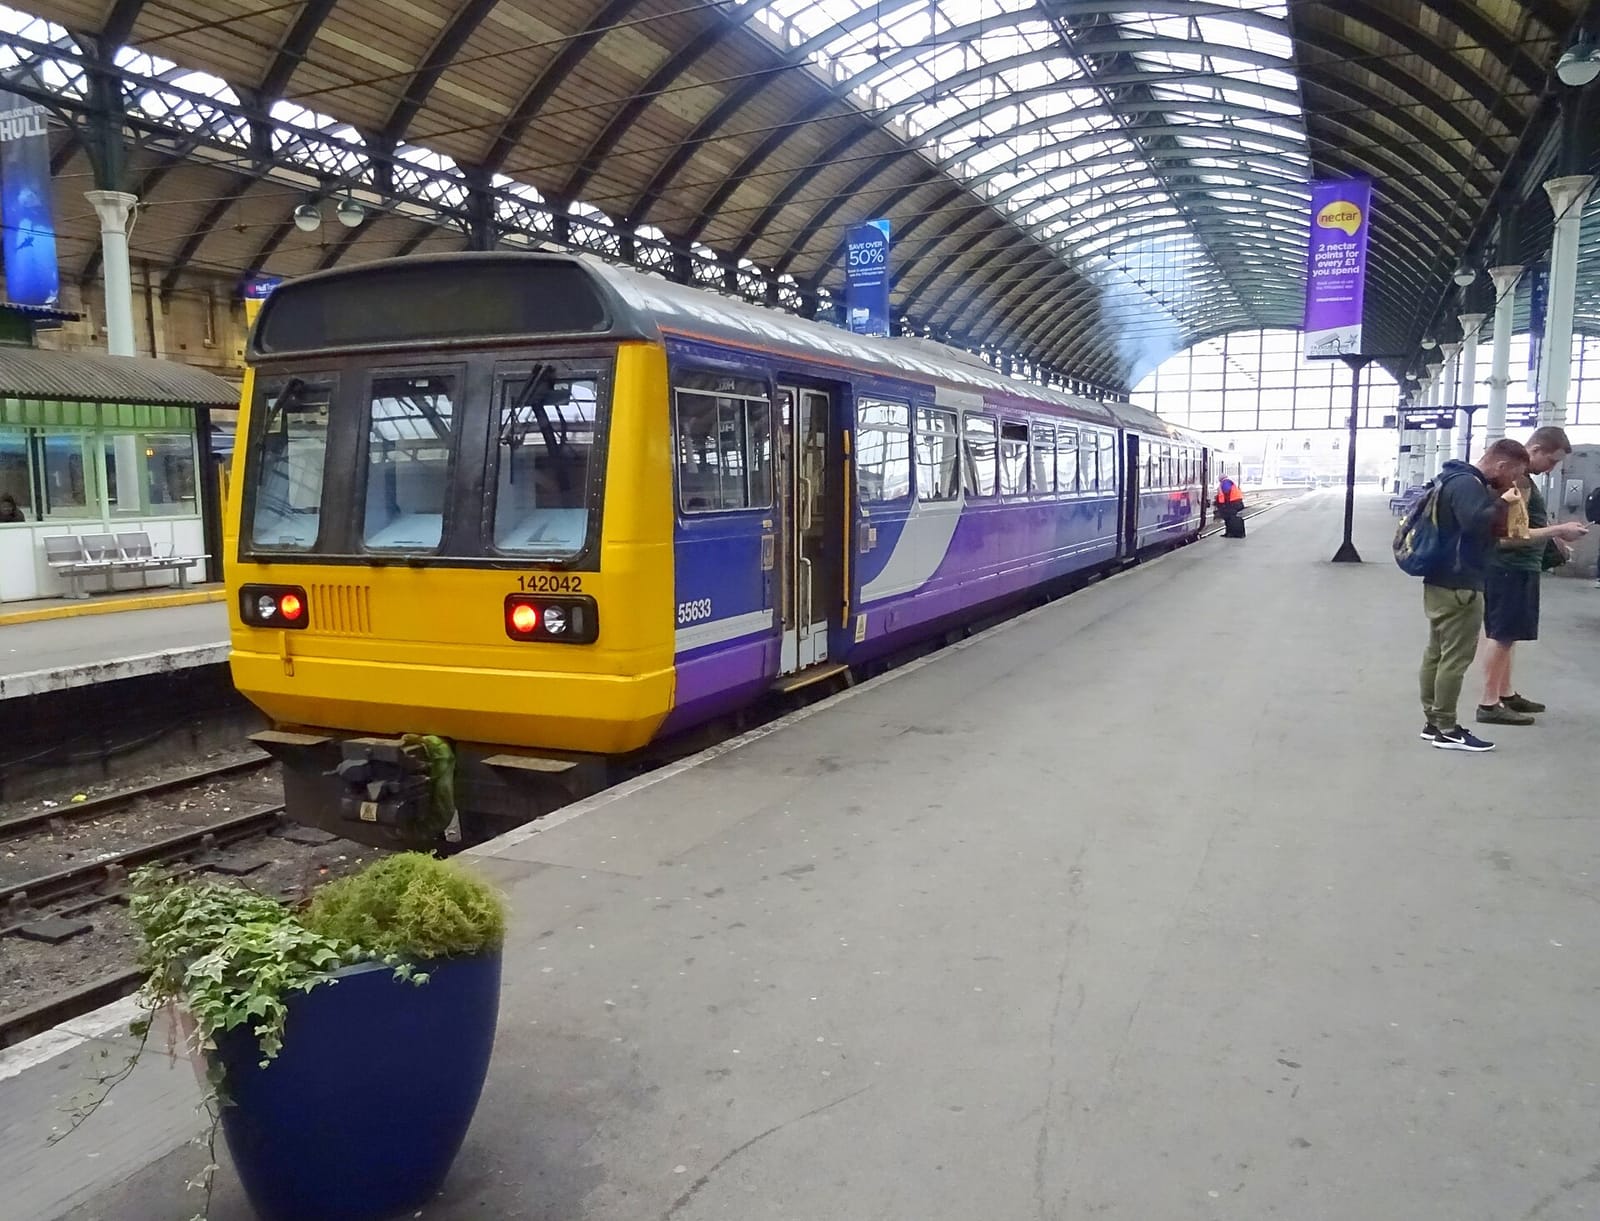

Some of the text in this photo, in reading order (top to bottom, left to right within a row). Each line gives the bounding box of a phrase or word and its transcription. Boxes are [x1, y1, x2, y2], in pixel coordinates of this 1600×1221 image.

[0, 115, 48, 142] HULL
[1321, 211, 1358, 223] nectar
[848, 240, 883, 251] SAVE OVER
[1318, 242, 1357, 252] 2 nectar
[849, 247, 884, 266] 50%
[1314, 250, 1360, 262] points for
[1317, 258, 1356, 268] every £1
[1312, 265, 1360, 278] you spend
[516, 575, 583, 593] 142042
[677, 597, 712, 624] 55633
